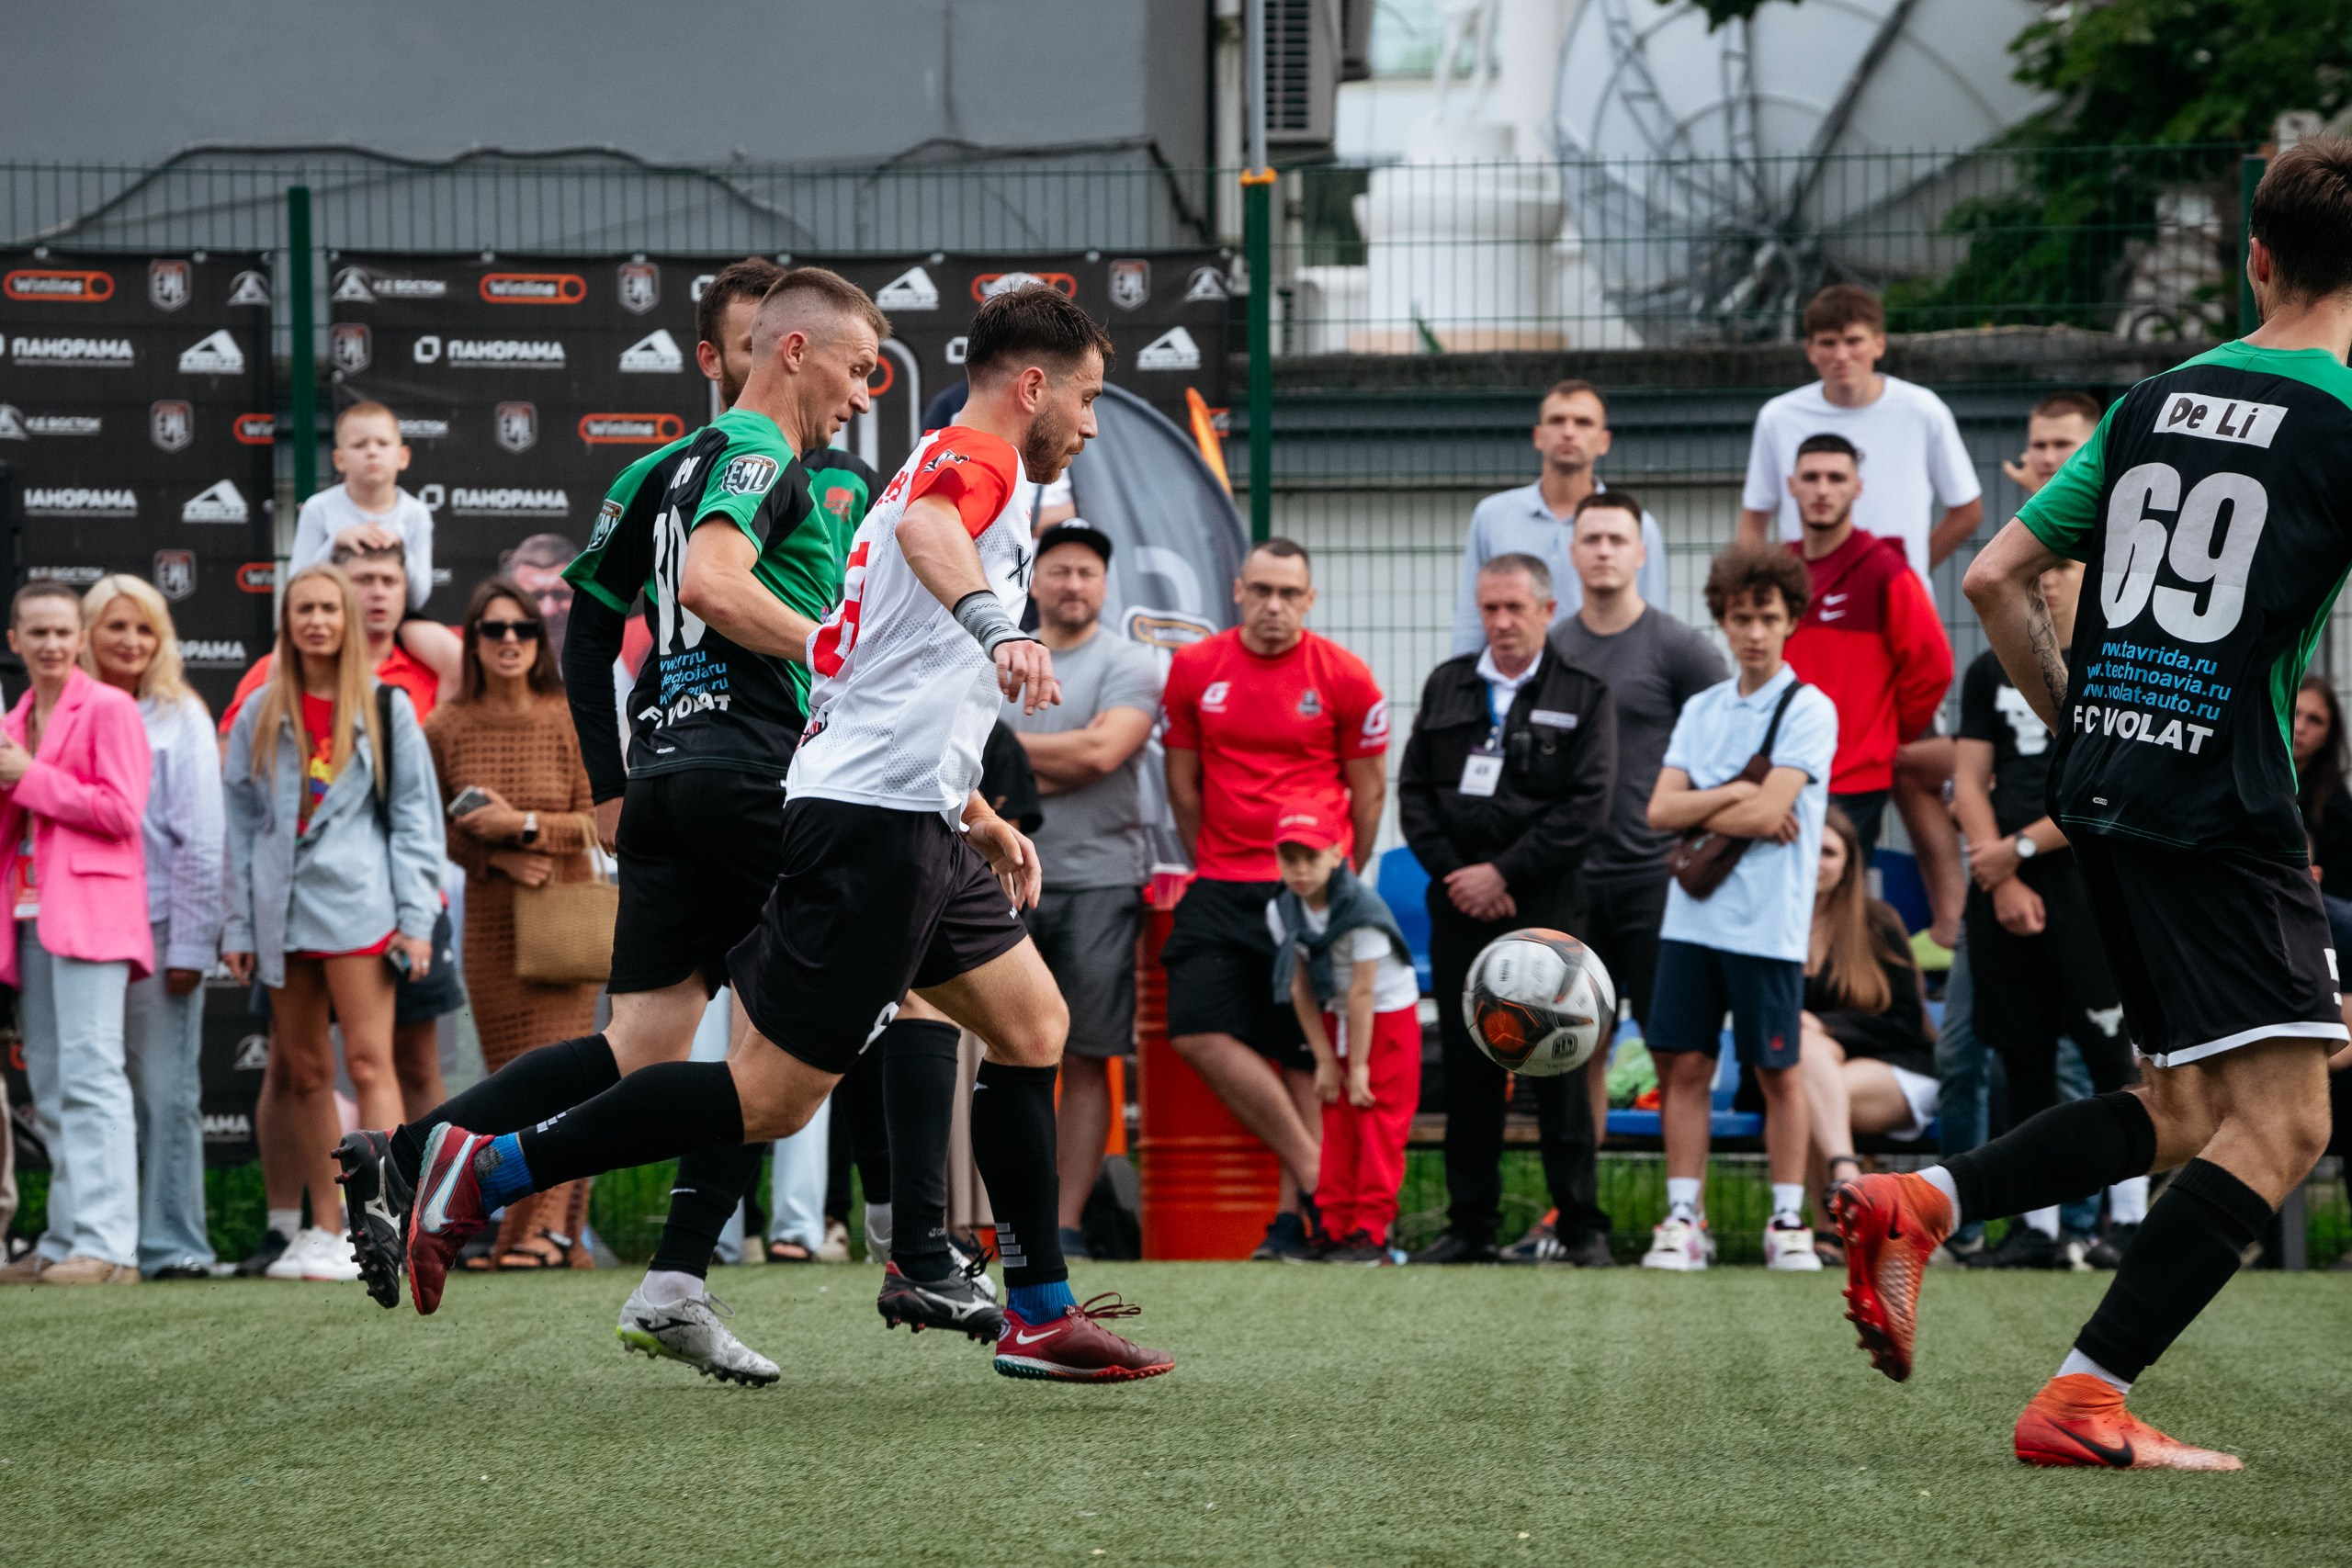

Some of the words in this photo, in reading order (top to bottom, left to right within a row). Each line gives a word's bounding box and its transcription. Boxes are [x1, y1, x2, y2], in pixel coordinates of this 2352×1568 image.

[11, 336, 135, 359] ПАНОРАМА
[447, 340, 566, 361] ПАНОРАМА
[2167, 397, 2209, 430] De
[2215, 402, 2259, 439] Li
[451, 488, 570, 509] ПАНОРАМА
[2100, 461, 2269, 643] 69
[2074, 705, 2102, 734] FC
[2103, 706, 2214, 755] VOLAT
